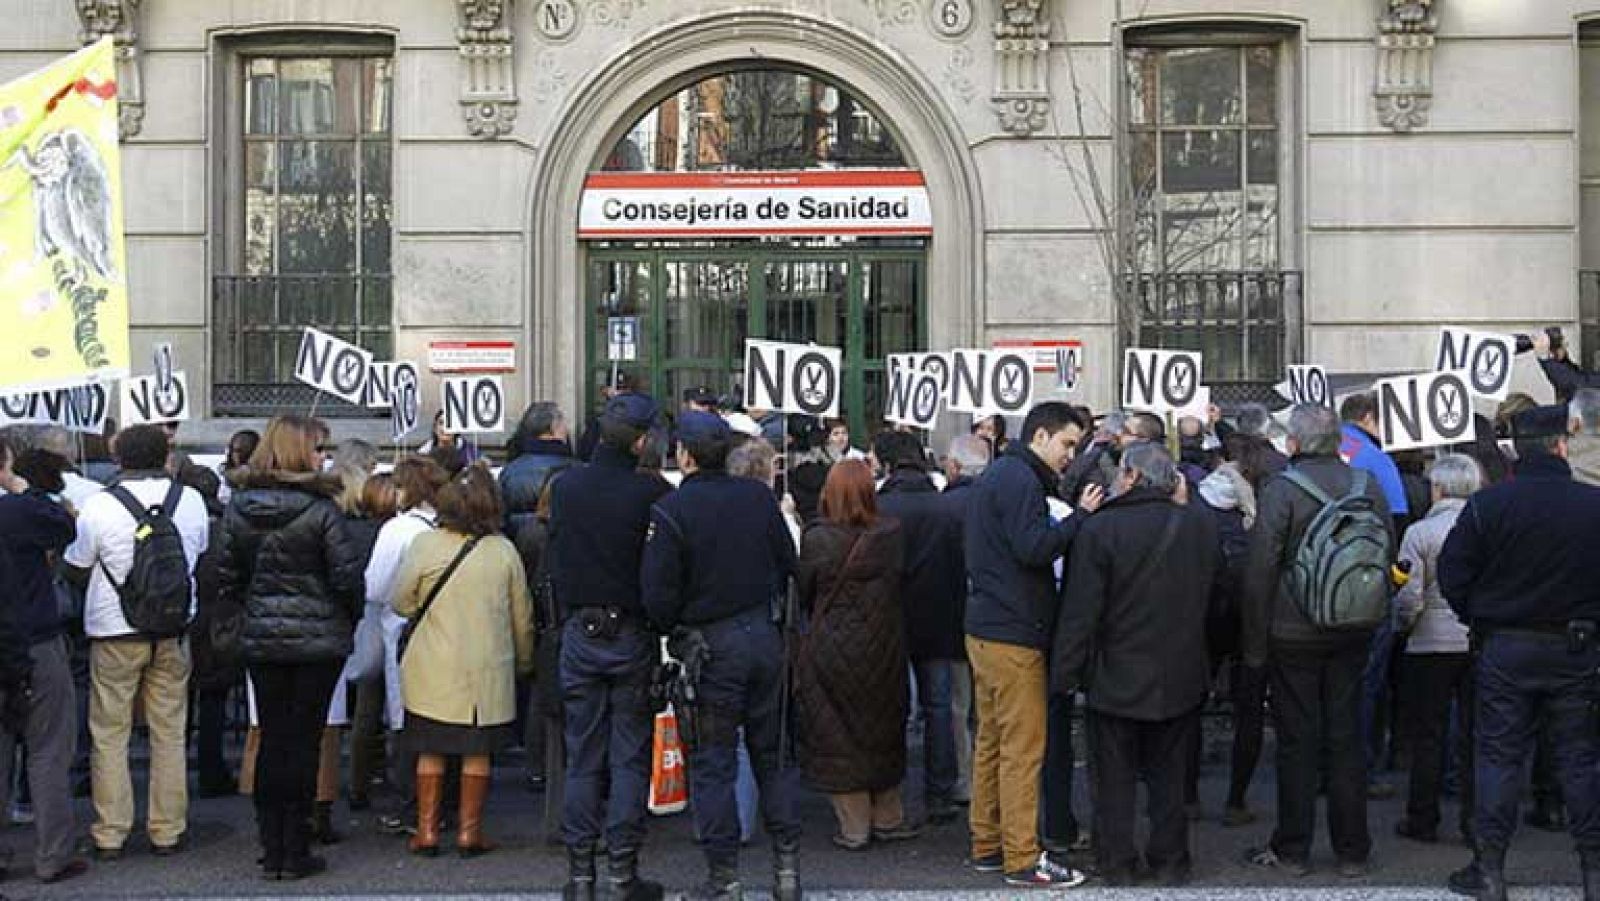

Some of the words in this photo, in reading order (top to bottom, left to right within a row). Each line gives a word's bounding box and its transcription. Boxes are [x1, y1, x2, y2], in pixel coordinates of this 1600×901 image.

[941, 1, 959, 28] 6
[602, 196, 748, 225] Consejería
[756, 196, 790, 220] de
[797, 195, 909, 221] Sanidad
[297, 331, 366, 395] NO
[747, 345, 836, 414] NO
[951, 351, 1031, 411] NO
[1125, 351, 1198, 408] NO
[1289, 367, 1326, 406] NO
[1437, 330, 1510, 395] NO
[445, 378, 502, 429] NO
[886, 371, 939, 424] NO
[1380, 373, 1470, 446] NO
